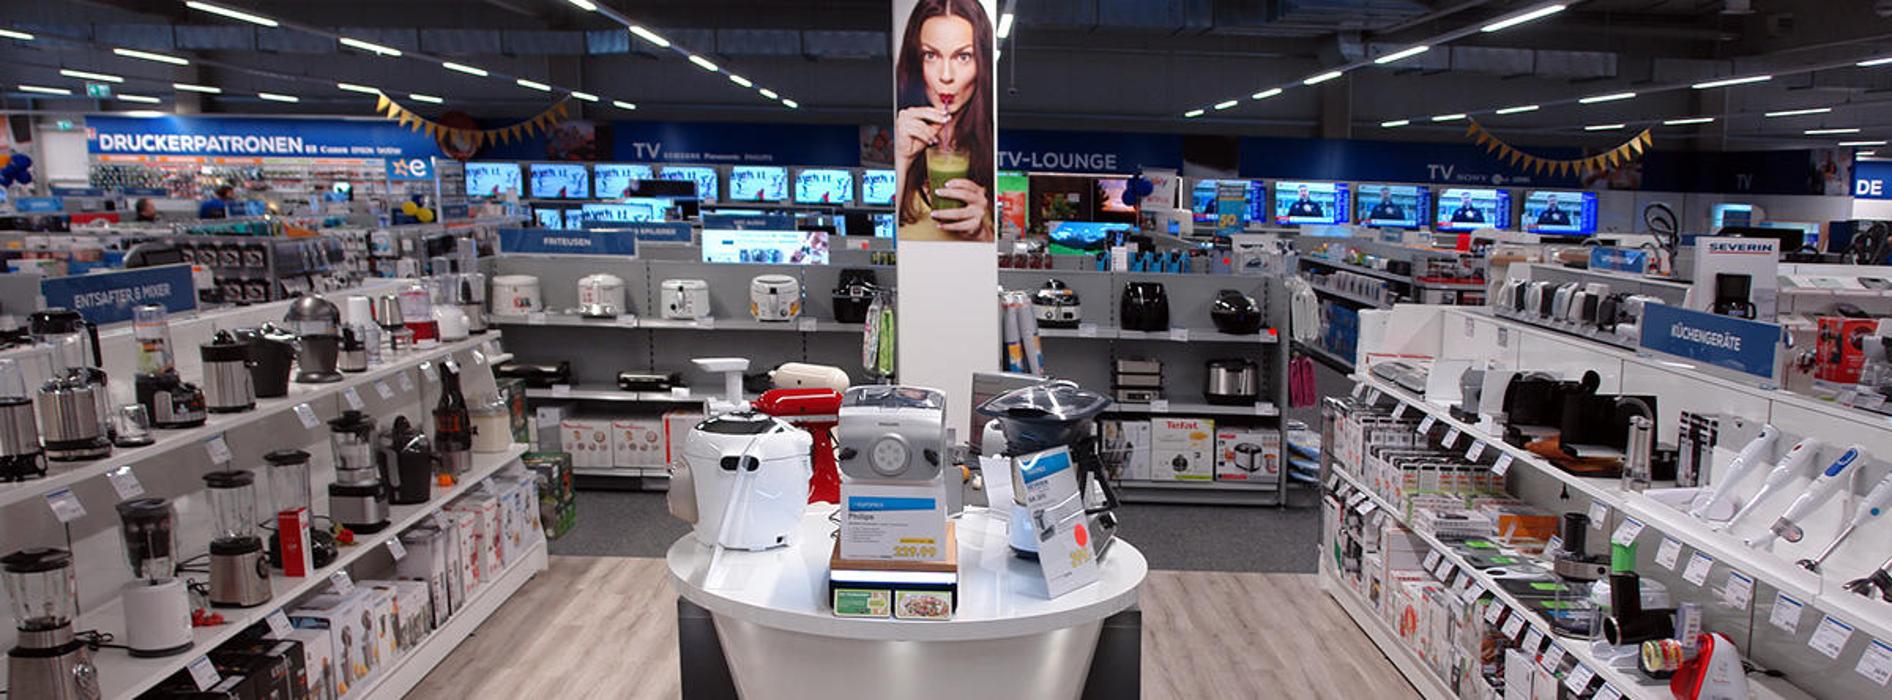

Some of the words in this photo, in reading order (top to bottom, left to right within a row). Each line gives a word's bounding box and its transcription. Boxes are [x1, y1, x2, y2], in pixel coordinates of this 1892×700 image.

[99, 134, 303, 154] DRUCKERPATRONEN
[632, 142, 661, 159] TV
[998, 151, 1118, 170] TV-LOUNGE
[1427, 164, 1454, 180] TV
[1736, 174, 1753, 190] TV
[1855, 179, 1883, 196] DE
[543, 237, 592, 246] FRITEUSEN
[1709, 243, 1773, 252] SEVERIN
[74, 287, 135, 309] ENTSAFTER
[142, 282, 171, 299] MIXER
[1671, 321, 1742, 352] KÜCHENGERÄTE
